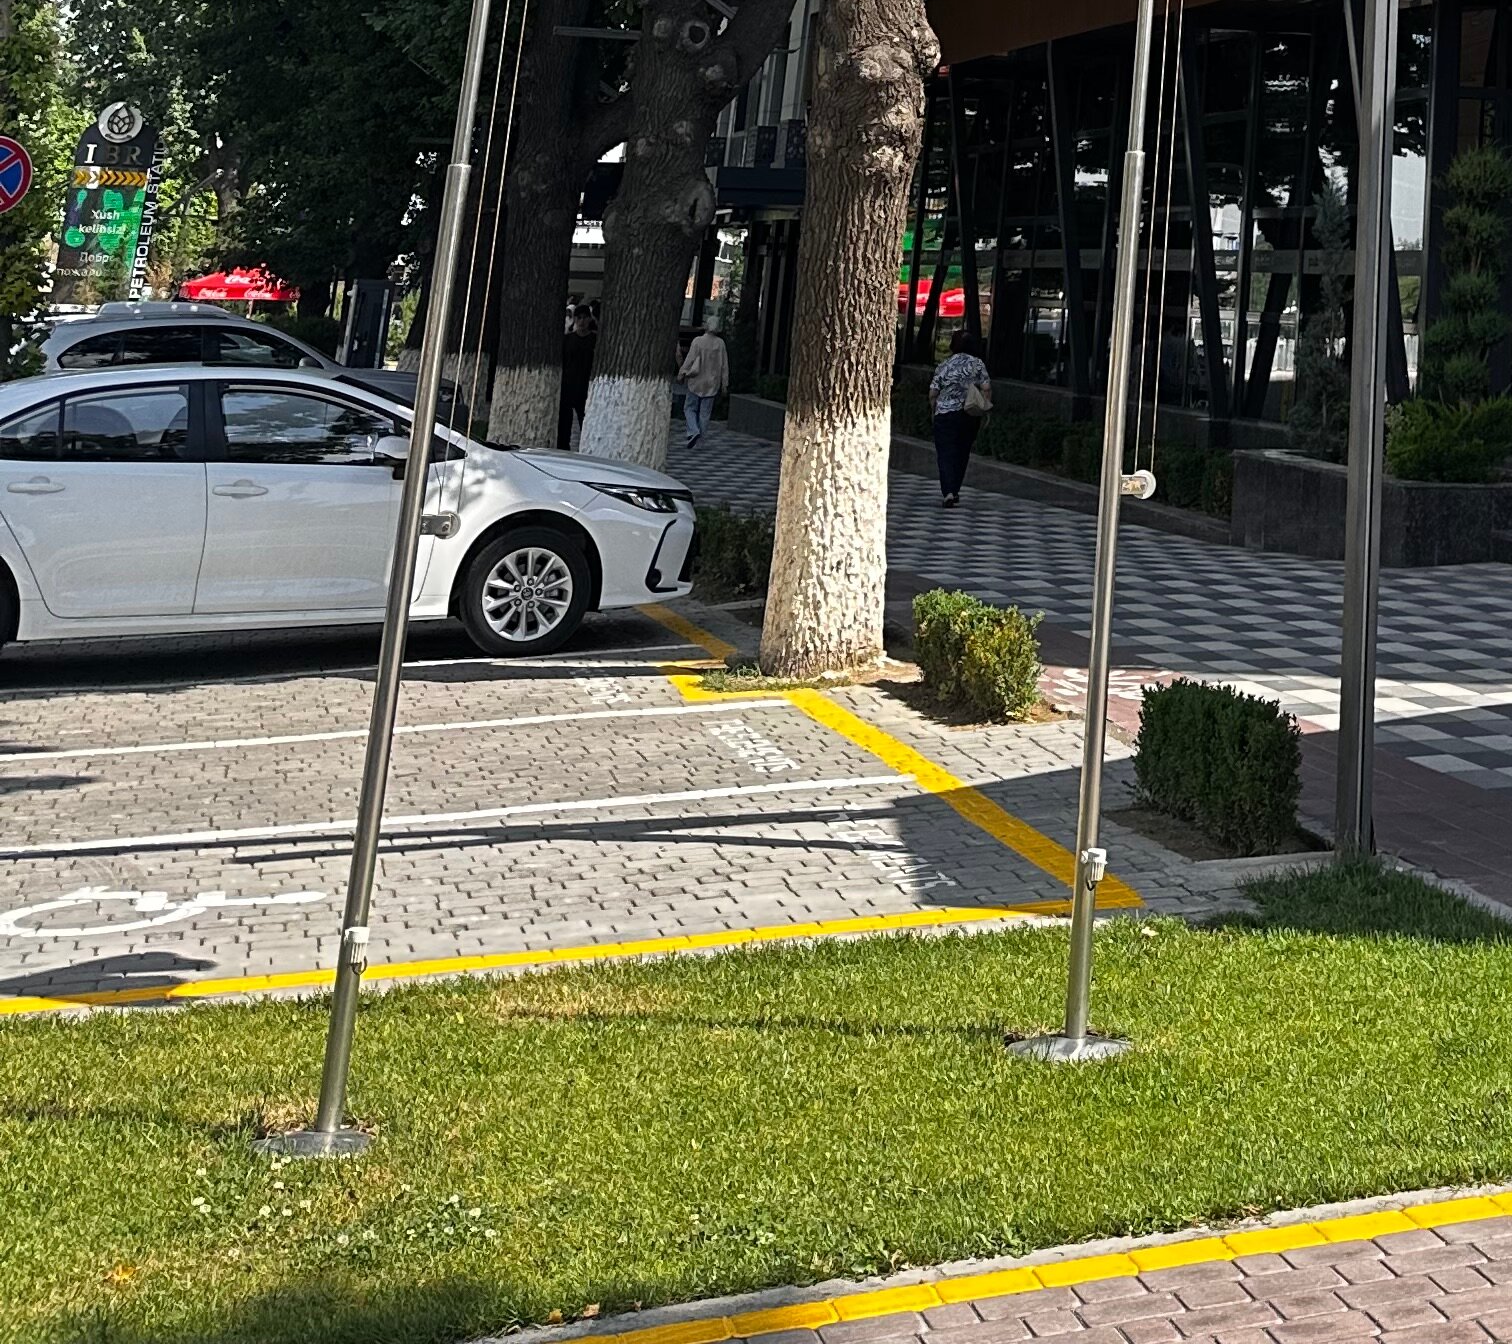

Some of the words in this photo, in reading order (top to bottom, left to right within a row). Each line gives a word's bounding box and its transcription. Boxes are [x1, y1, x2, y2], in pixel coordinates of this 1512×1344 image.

[91, 209, 120, 220] Xush
[129, 201, 157, 299] PETROLEUM
[147, 141, 166, 194] STATIO
